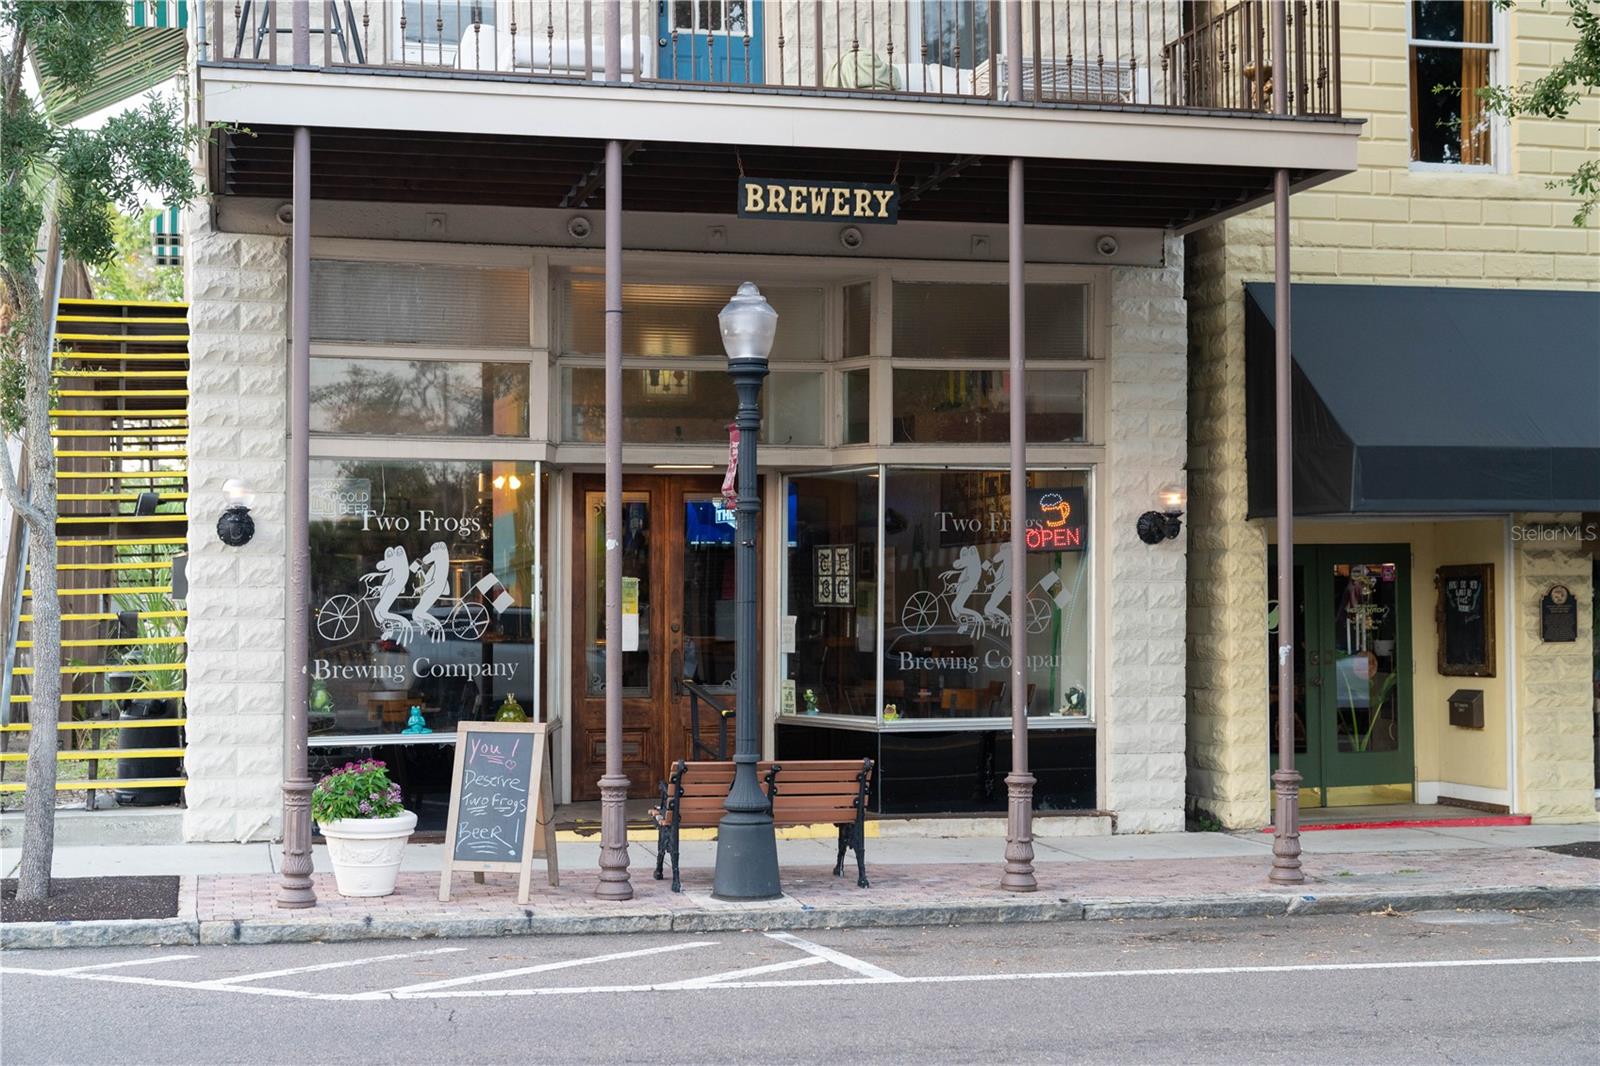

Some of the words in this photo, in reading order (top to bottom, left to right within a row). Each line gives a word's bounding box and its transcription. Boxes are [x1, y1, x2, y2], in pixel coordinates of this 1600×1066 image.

[744, 183, 895, 218] BREWERY
[340, 492, 369, 503] COLD
[340, 503, 369, 516] BEER
[355, 510, 410, 532] Two
[418, 510, 482, 536] Frogs
[934, 512, 982, 533] Two
[1026, 528, 1080, 548] OPEN
[313, 658, 406, 681] Brewing
[412, 656, 519, 680] Company
[899, 651, 979, 673] Brewing
[464, 769, 525, 791] Deserve
